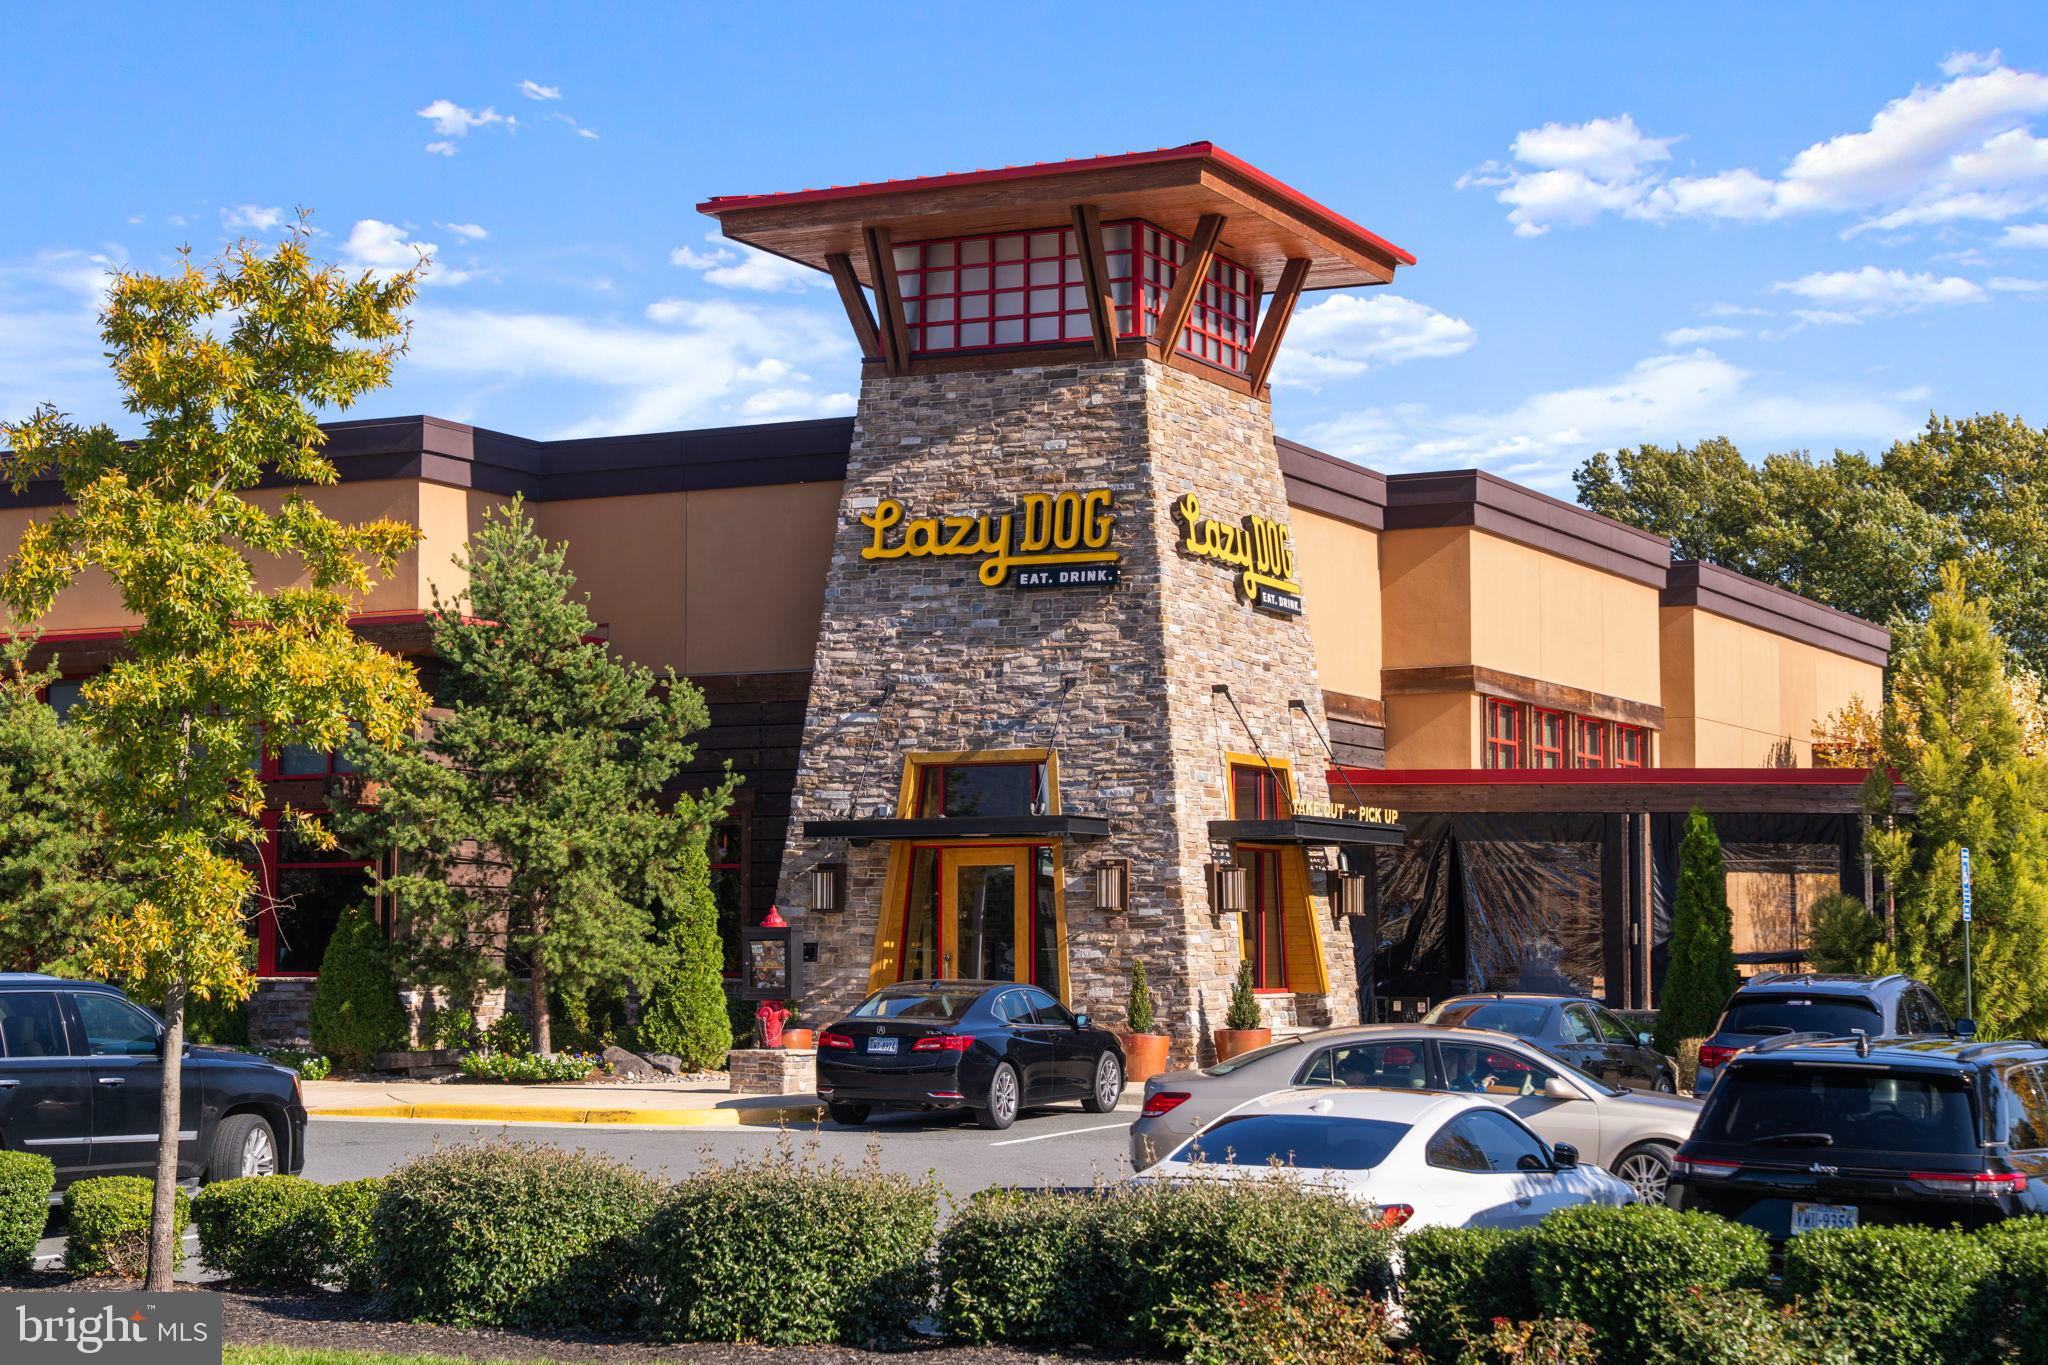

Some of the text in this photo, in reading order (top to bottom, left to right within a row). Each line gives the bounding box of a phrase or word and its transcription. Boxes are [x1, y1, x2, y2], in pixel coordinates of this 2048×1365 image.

[860, 489, 1114, 586] Lazy DOG
[1180, 493, 1293, 599] Lazy DOG
[1019, 569, 1113, 585] EAT. DRINK.
[1262, 592, 1301, 611] EAT. DRINK.
[1324, 802, 1345, 820] OUT
[1359, 806, 1382, 823] PICK
[1384, 808, 1398, 825] UP
